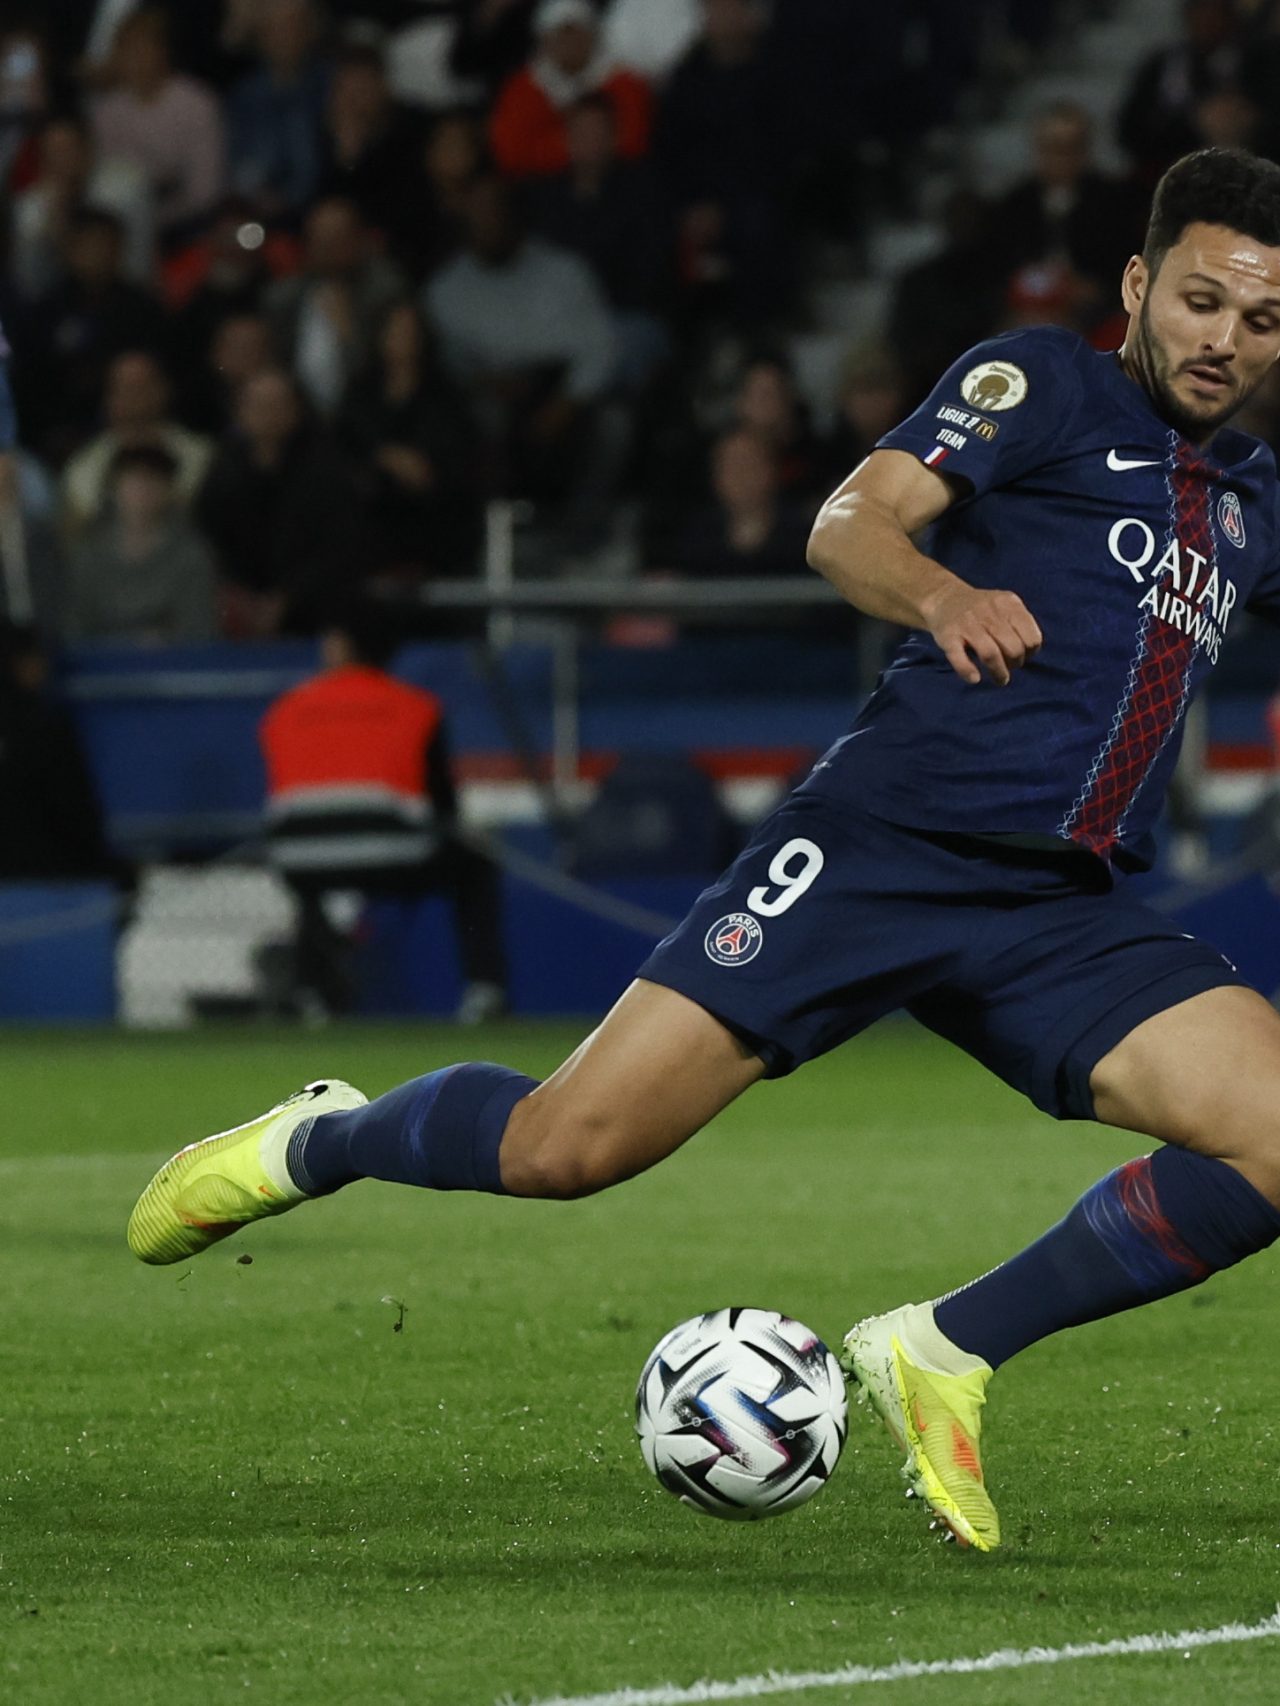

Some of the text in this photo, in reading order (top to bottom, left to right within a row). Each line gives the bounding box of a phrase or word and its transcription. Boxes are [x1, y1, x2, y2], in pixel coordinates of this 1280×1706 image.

[935, 406, 970, 426] LIGUE
[1107, 517, 1237, 634] QATAR
[1137, 584, 1223, 665] AIRWAYS
[746, 837, 825, 918] 9
[728, 915, 760, 939] PARIS
